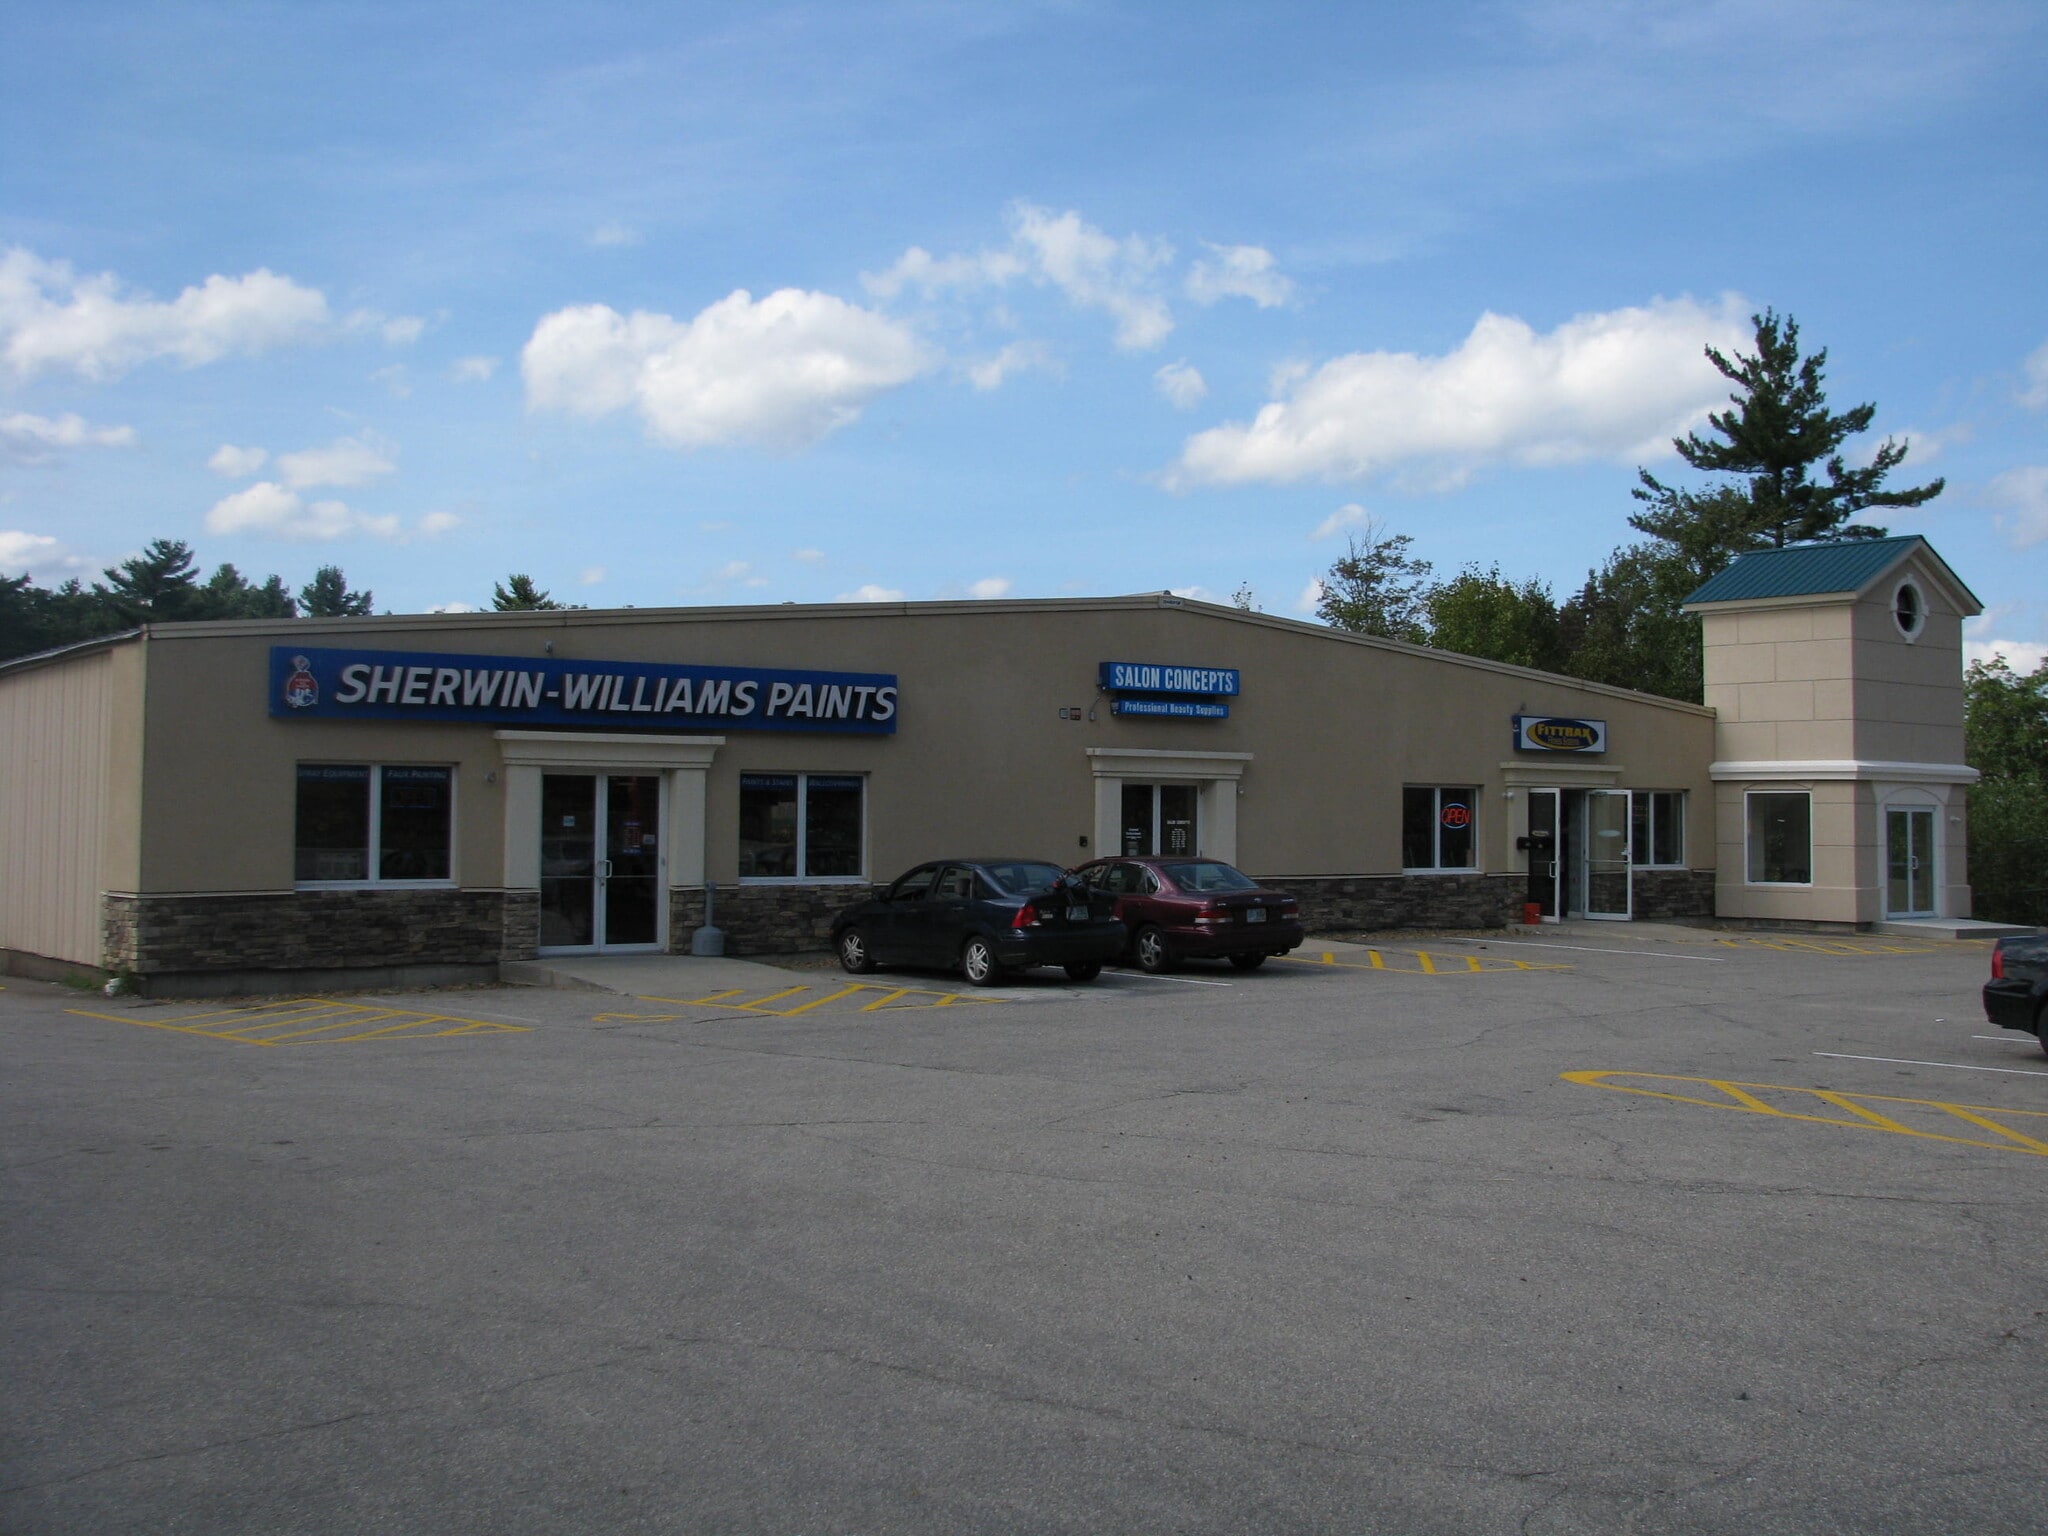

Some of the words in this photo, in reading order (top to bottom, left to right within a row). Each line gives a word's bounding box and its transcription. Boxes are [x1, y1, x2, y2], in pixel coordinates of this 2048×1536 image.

[1115, 665, 1160, 688] SALON
[1165, 668, 1234, 692] CONCEPTS
[335, 664, 758, 716] SHERWIN-WILLIAMS
[766, 682, 897, 721] PAINTS
[1125, 702, 1168, 713] Professional
[1170, 704, 1193, 716] Beauty
[1196, 705, 1224, 717] Supplies
[1441, 807, 1472, 824] OPEN
